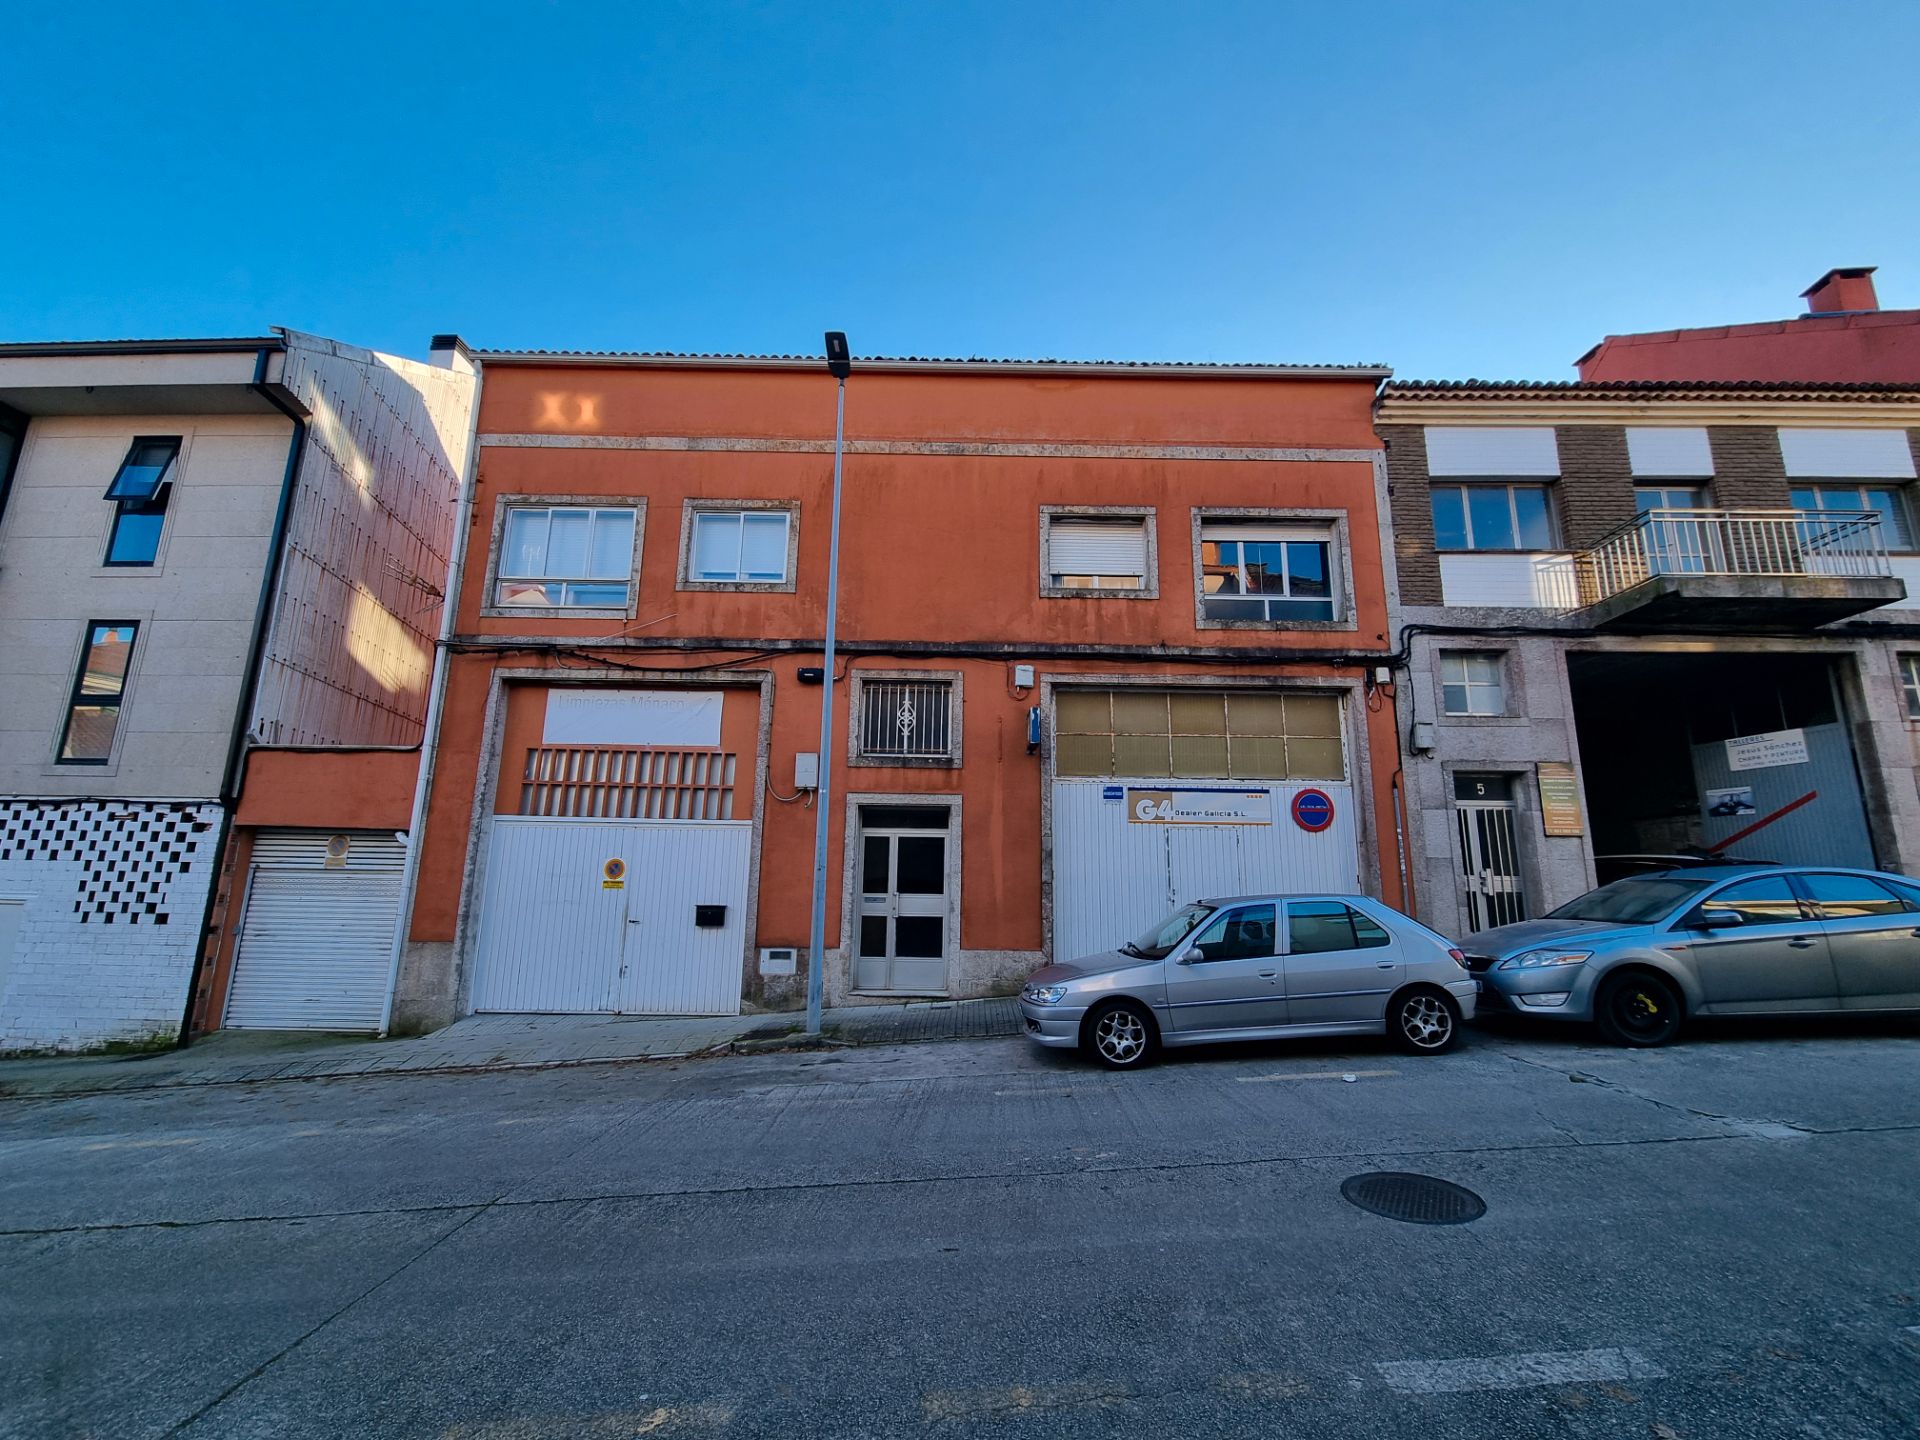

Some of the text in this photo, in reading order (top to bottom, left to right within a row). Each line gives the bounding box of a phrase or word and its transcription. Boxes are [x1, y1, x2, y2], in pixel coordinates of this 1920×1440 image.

[1477, 783, 1485, 795] 5
[1135, 799, 1174, 821] G4
[1205, 810, 1232, 818] Galicia
